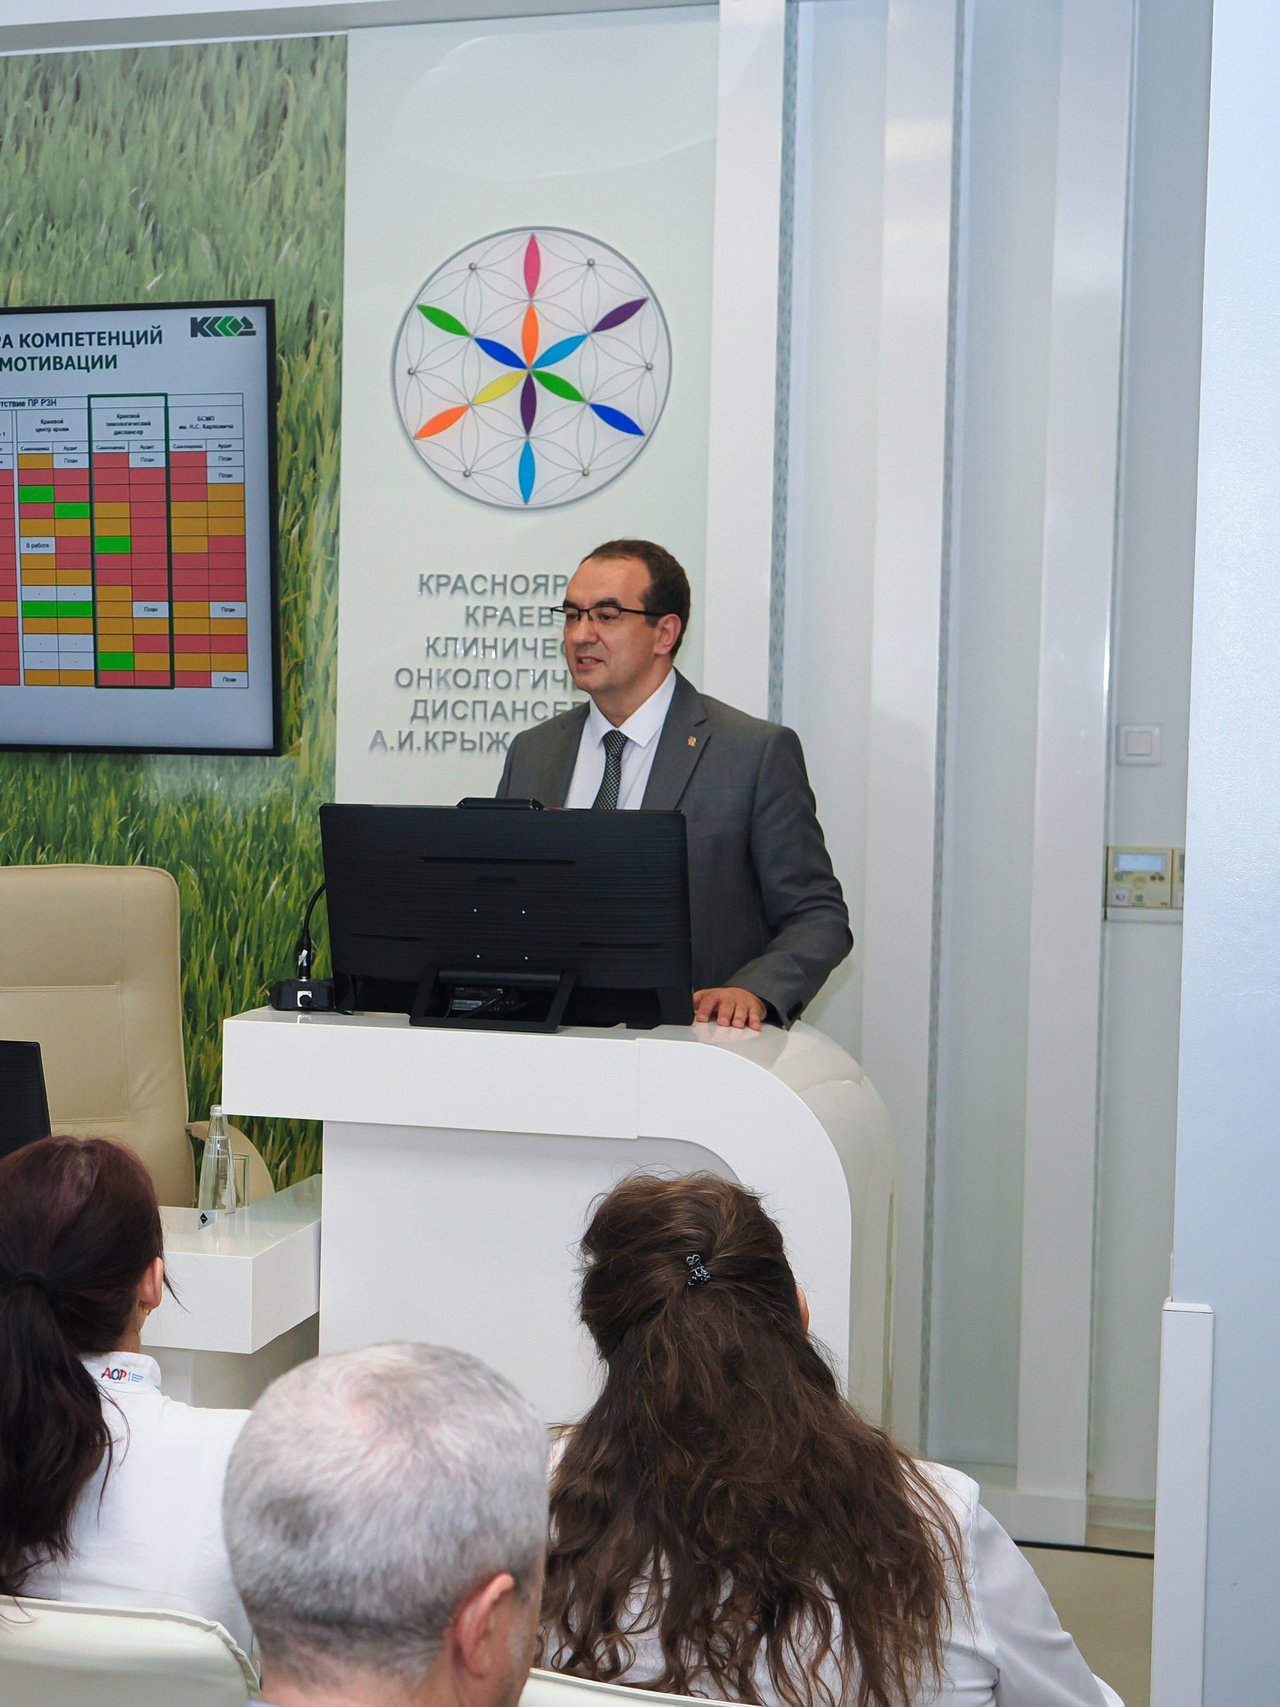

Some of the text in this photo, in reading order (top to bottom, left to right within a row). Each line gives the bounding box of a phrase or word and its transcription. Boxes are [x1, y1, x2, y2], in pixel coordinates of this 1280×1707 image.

[20, 325, 163, 348] КОМПЕТЕНЦИЙ
[0, 354, 118, 373] МОТИВАЦИИ
[28, 399, 39, 407] ПР
[41, 398, 57, 407] РЗН
[411, 699, 584, 723] ДИСПАНСЕ
